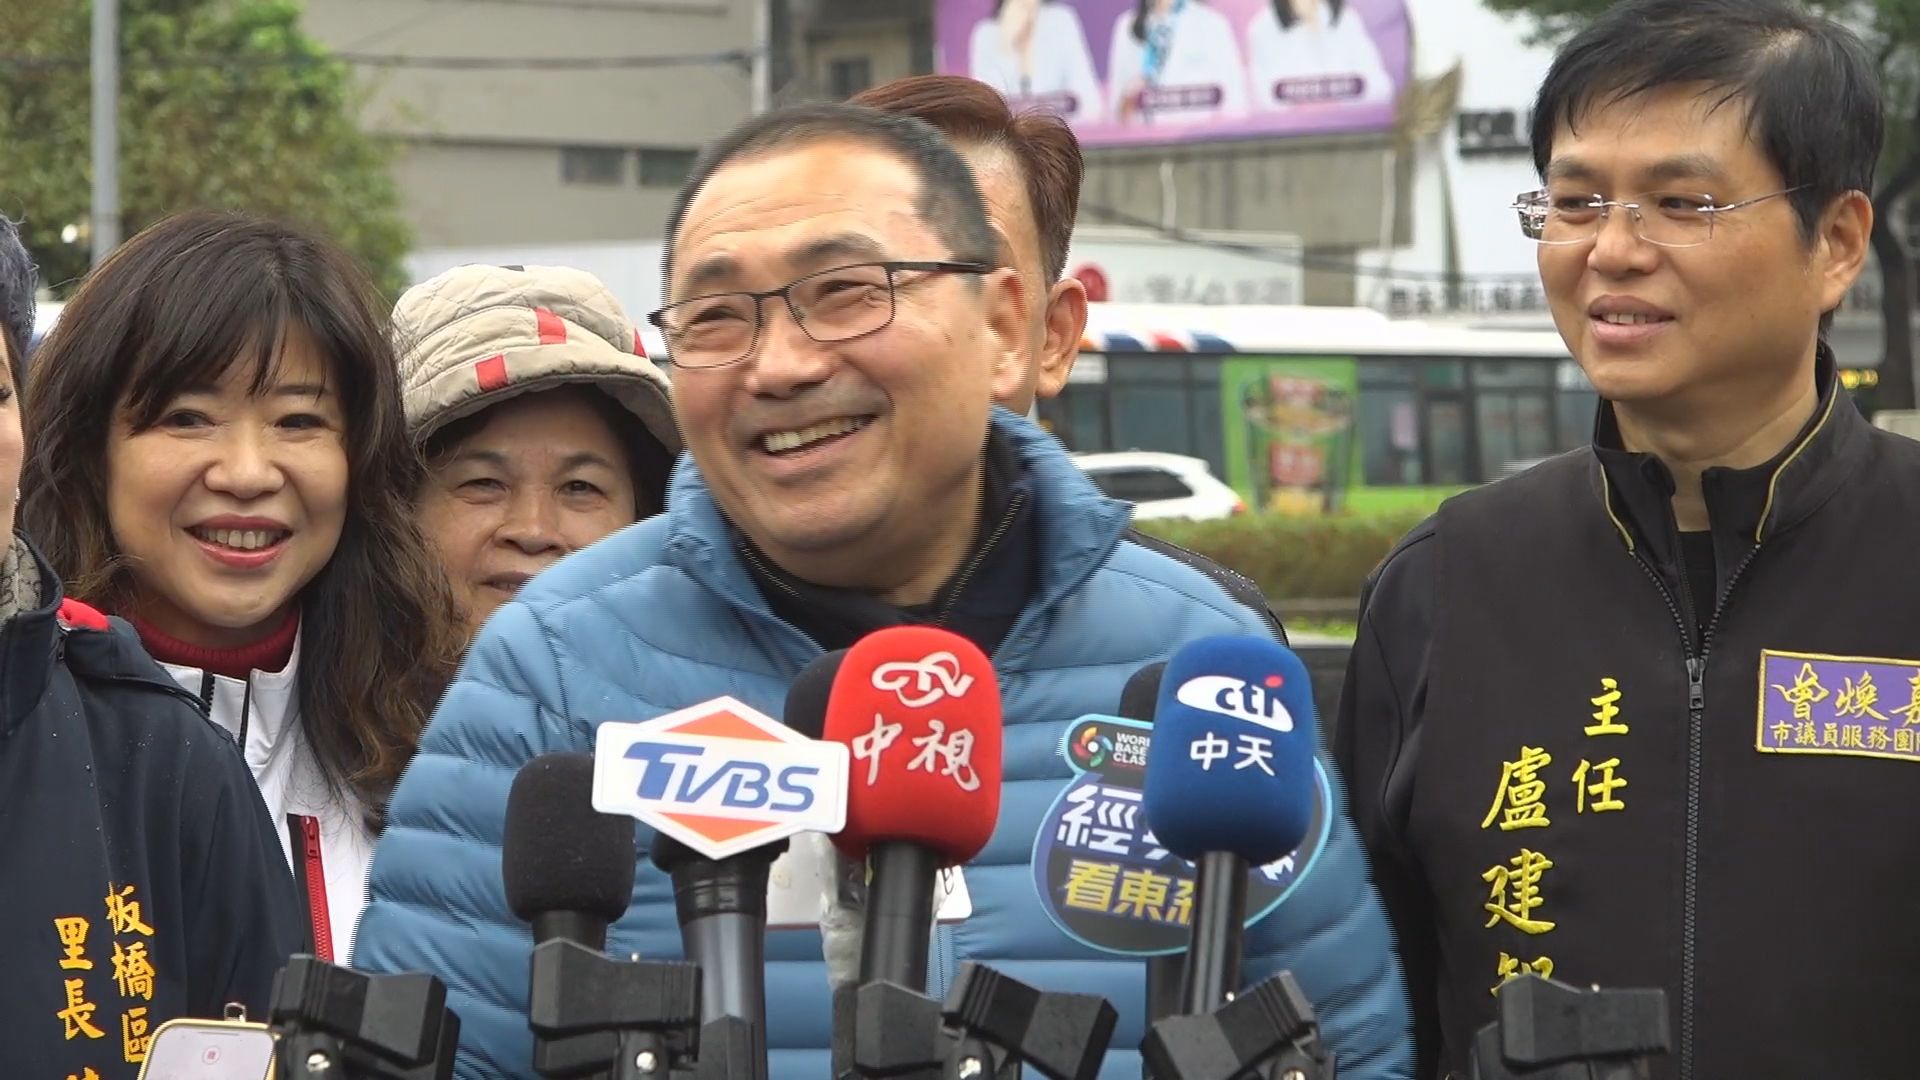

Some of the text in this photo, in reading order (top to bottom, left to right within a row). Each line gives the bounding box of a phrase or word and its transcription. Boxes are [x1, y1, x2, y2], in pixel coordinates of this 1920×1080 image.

[852, 713, 982, 793] 中視
[1190, 731, 1276, 777] 中天
[1572, 677, 1630, 814] 主任
[1769, 719, 1920, 752] 市議員服務團
[622, 740, 820, 813] TVBS
[54, 916, 106, 1080] 里長
[105, 881, 155, 1064] 板橋區
